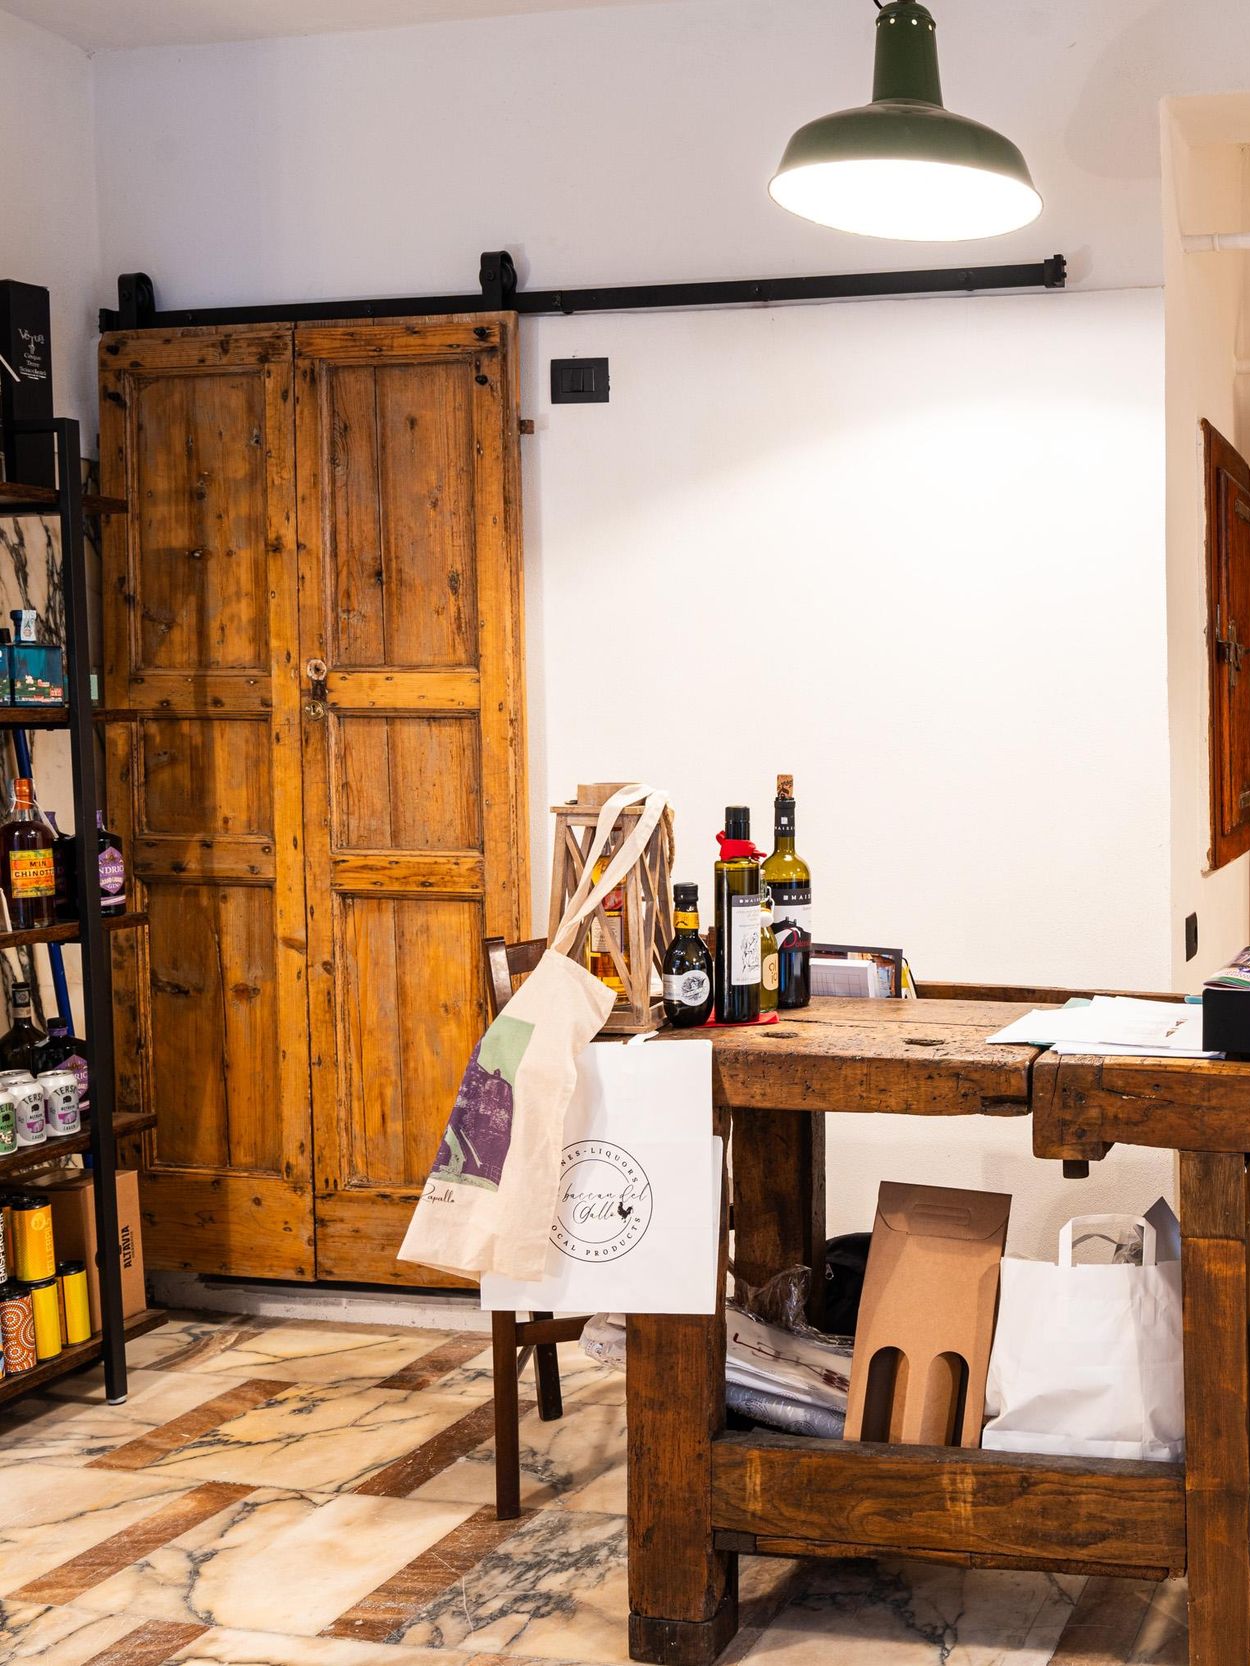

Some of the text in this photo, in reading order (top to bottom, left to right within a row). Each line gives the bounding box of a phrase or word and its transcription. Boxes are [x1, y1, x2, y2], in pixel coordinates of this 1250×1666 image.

[560, 1147, 638, 1183] NES-LIQUORS
[121, 1225, 133, 1269] ALTAVIA
[551, 1225, 576, 1252] OCAL
[586, 1217, 641, 1257] PRODUCTS
